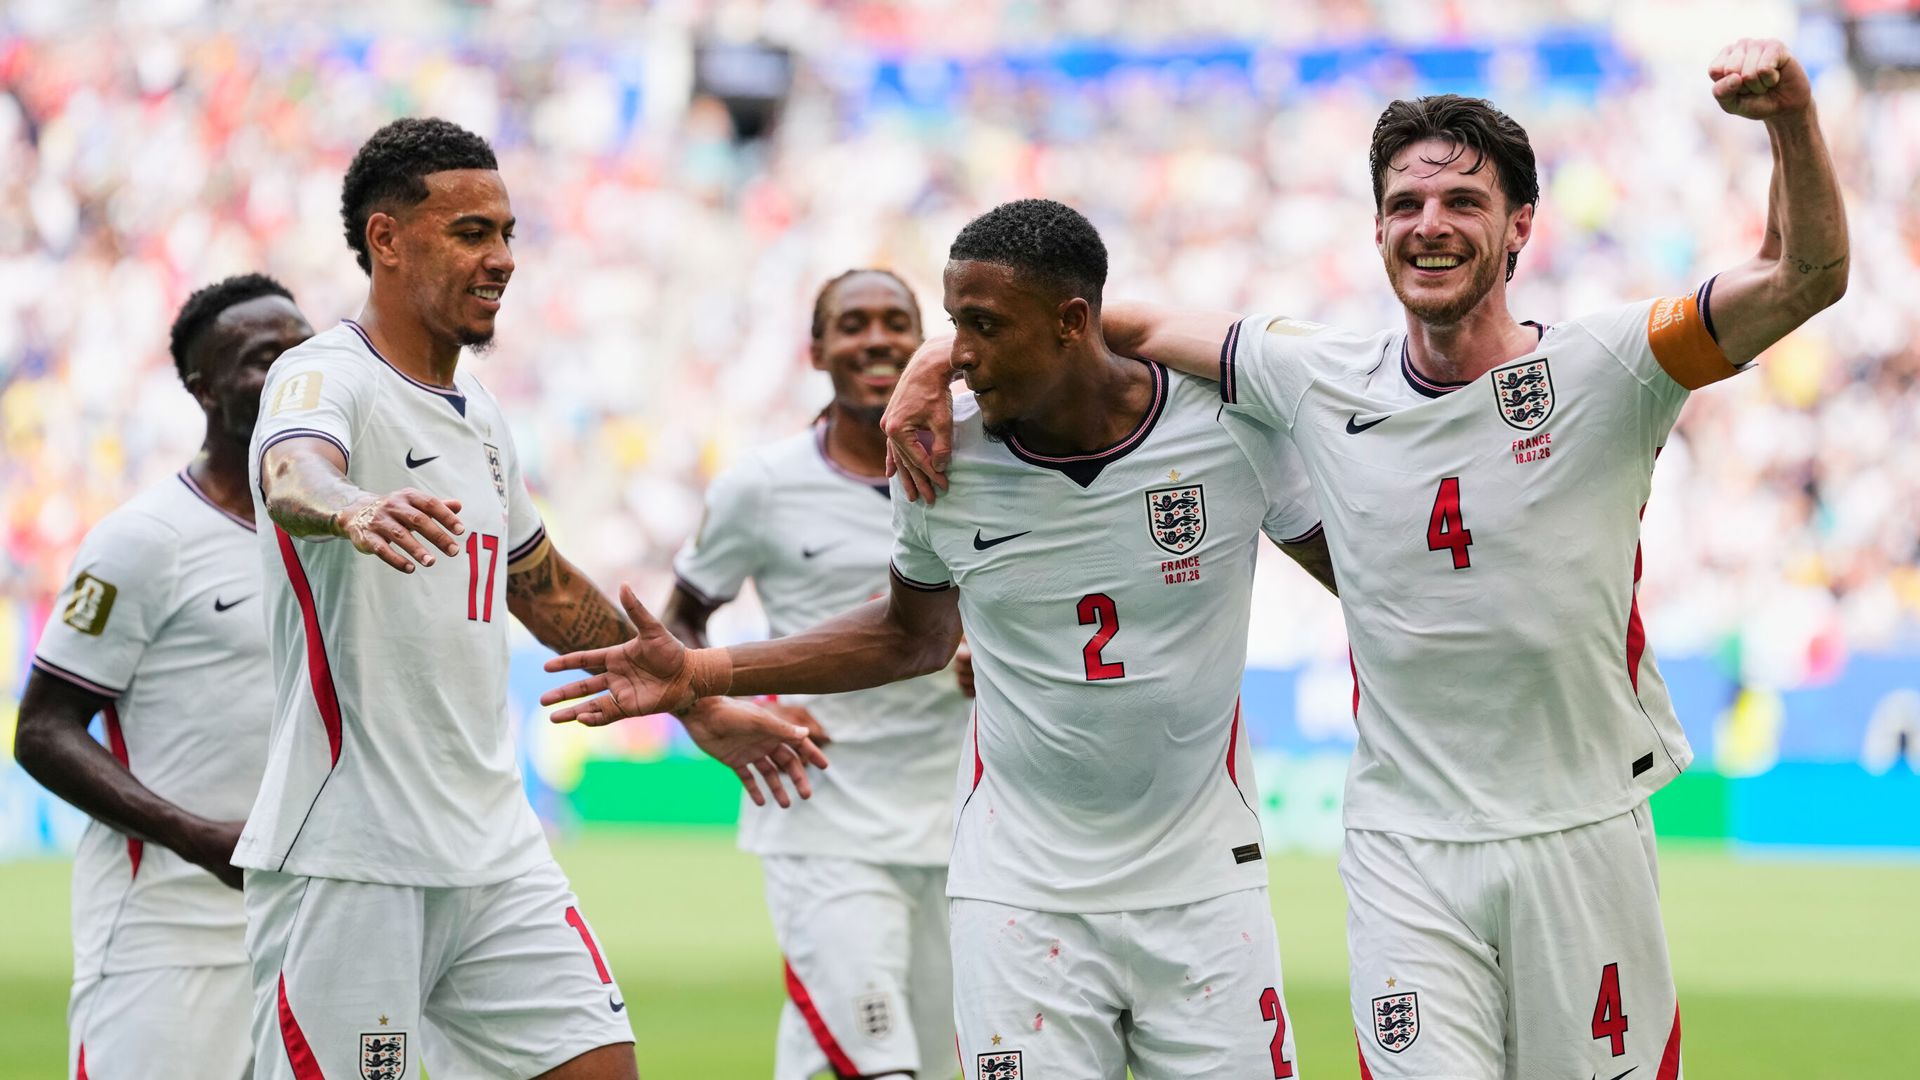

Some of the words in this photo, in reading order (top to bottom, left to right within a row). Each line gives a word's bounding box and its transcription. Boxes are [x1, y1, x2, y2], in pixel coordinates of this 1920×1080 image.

[1512, 433, 1552, 452] FRANCE
[1515, 447, 1551, 465] 18.07.26
[1161, 555, 1200, 572] FRANCE
[1426, 476, 1473, 570] 4
[466, 531, 499, 623] 17
[1164, 569, 1200, 585] 18.07.26
[1076, 592, 1125, 681] 2
[1258, 986, 1293, 1079] 2
[1591, 962, 1628, 1057] 4
